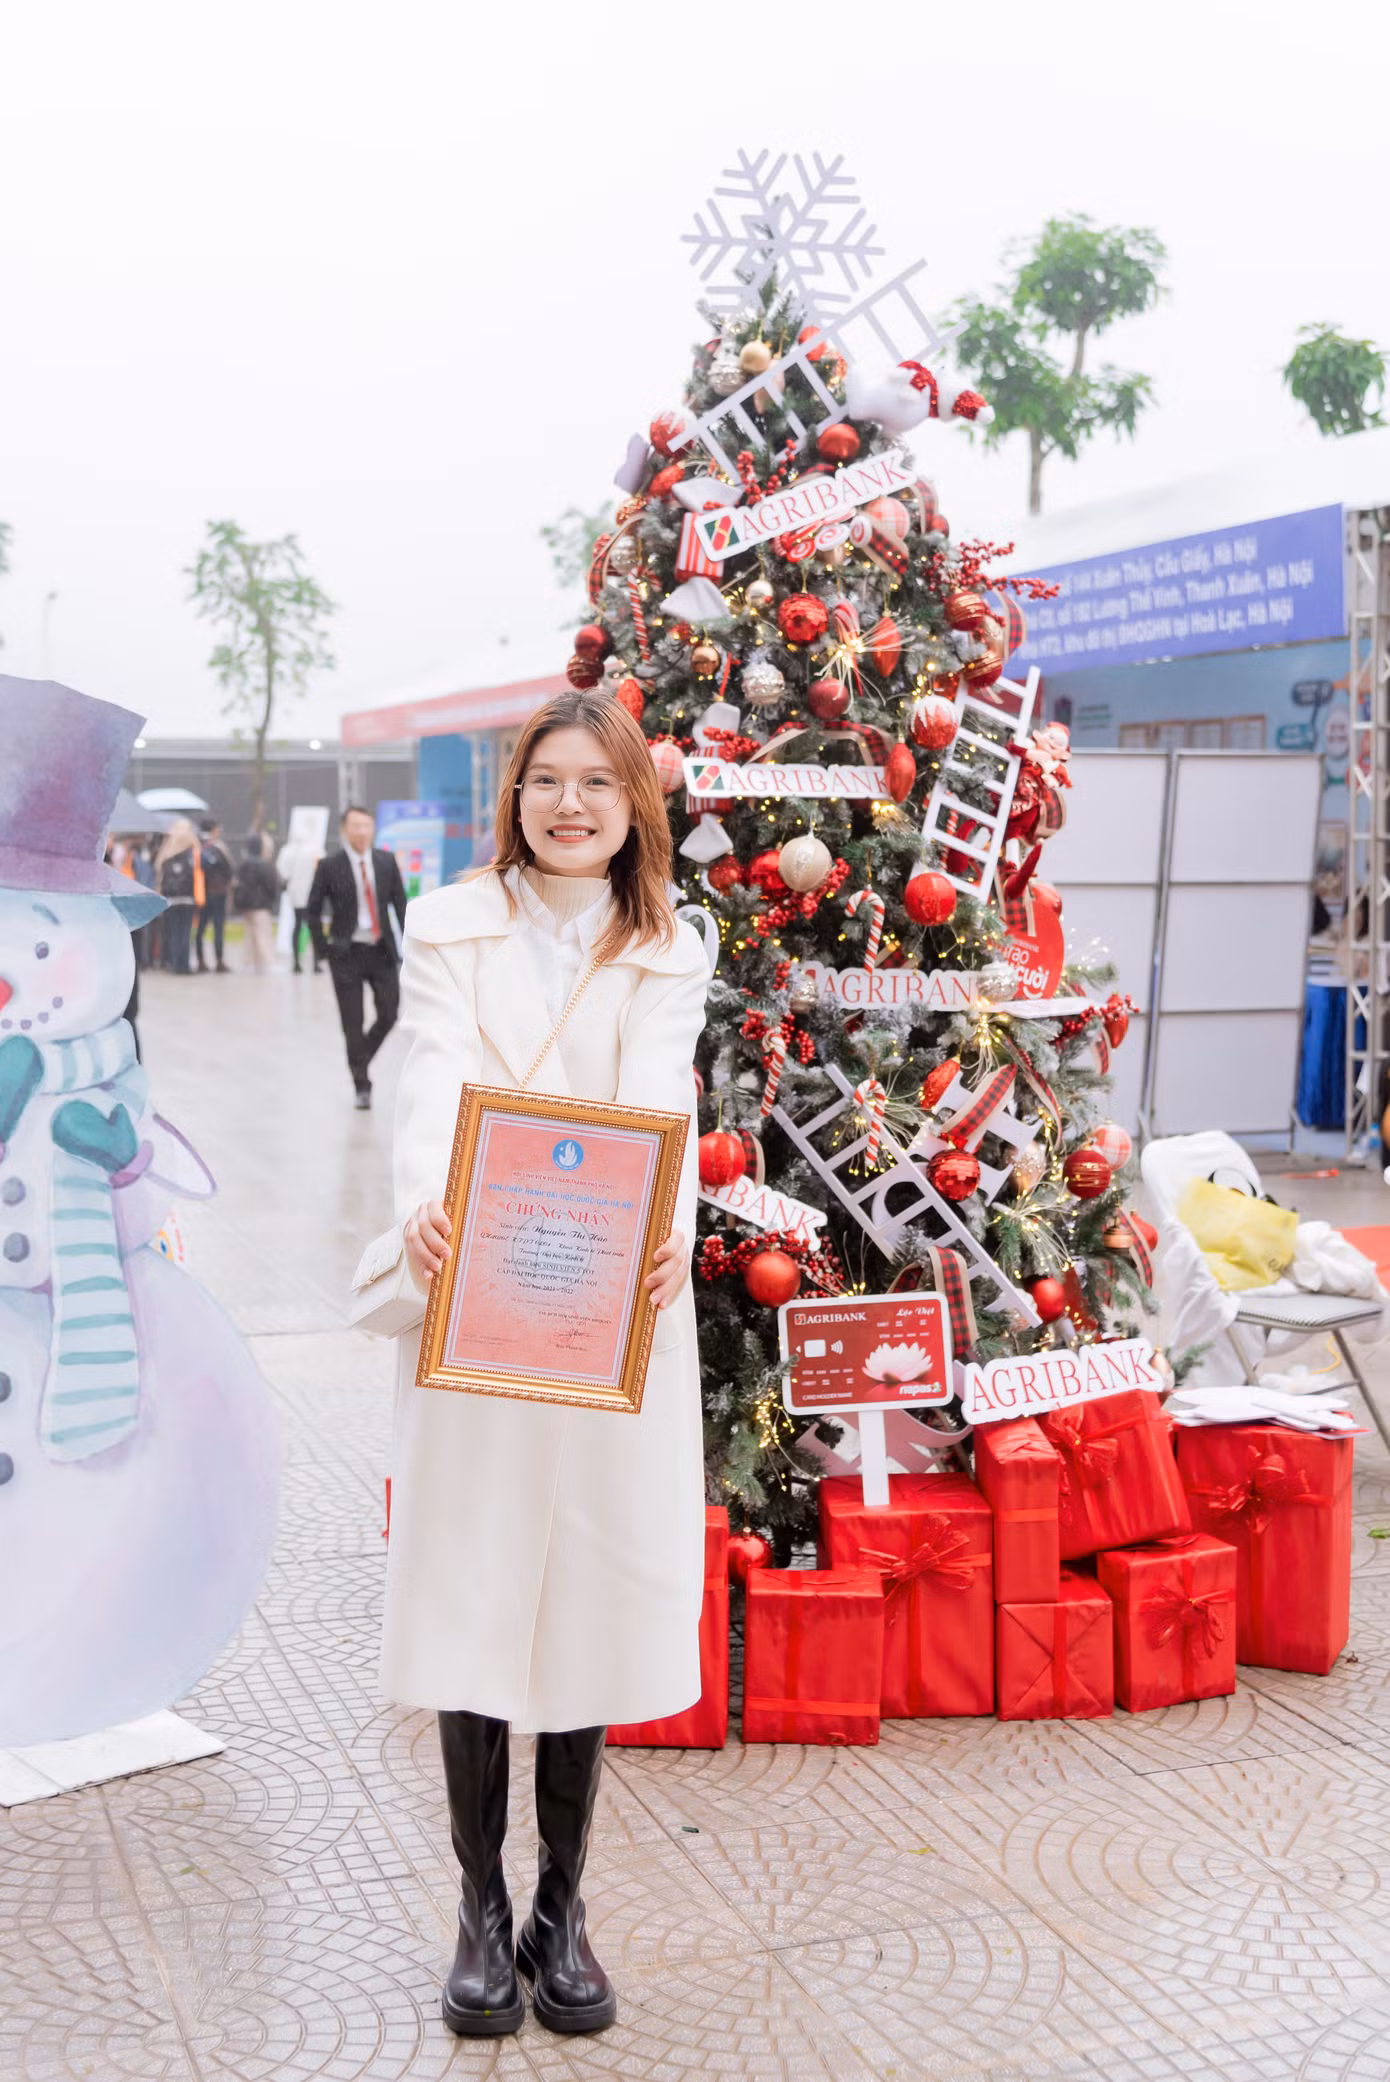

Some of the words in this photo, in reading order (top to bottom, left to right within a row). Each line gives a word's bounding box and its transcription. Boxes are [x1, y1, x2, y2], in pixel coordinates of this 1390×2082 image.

[742, 454, 909, 541] AGRIBANK
[1287, 556, 1314, 591] Nội
[1268, 594, 1294, 630] Nội
[823, 973, 974, 1006] AGRIBAN
[505, 1198, 562, 1220] CHỨNG
[567, 1207, 610, 1228] NHẬN
[806, 1312, 866, 1325] AGRIBANK
[972, 1347, 1156, 1413] AGRIBANK
